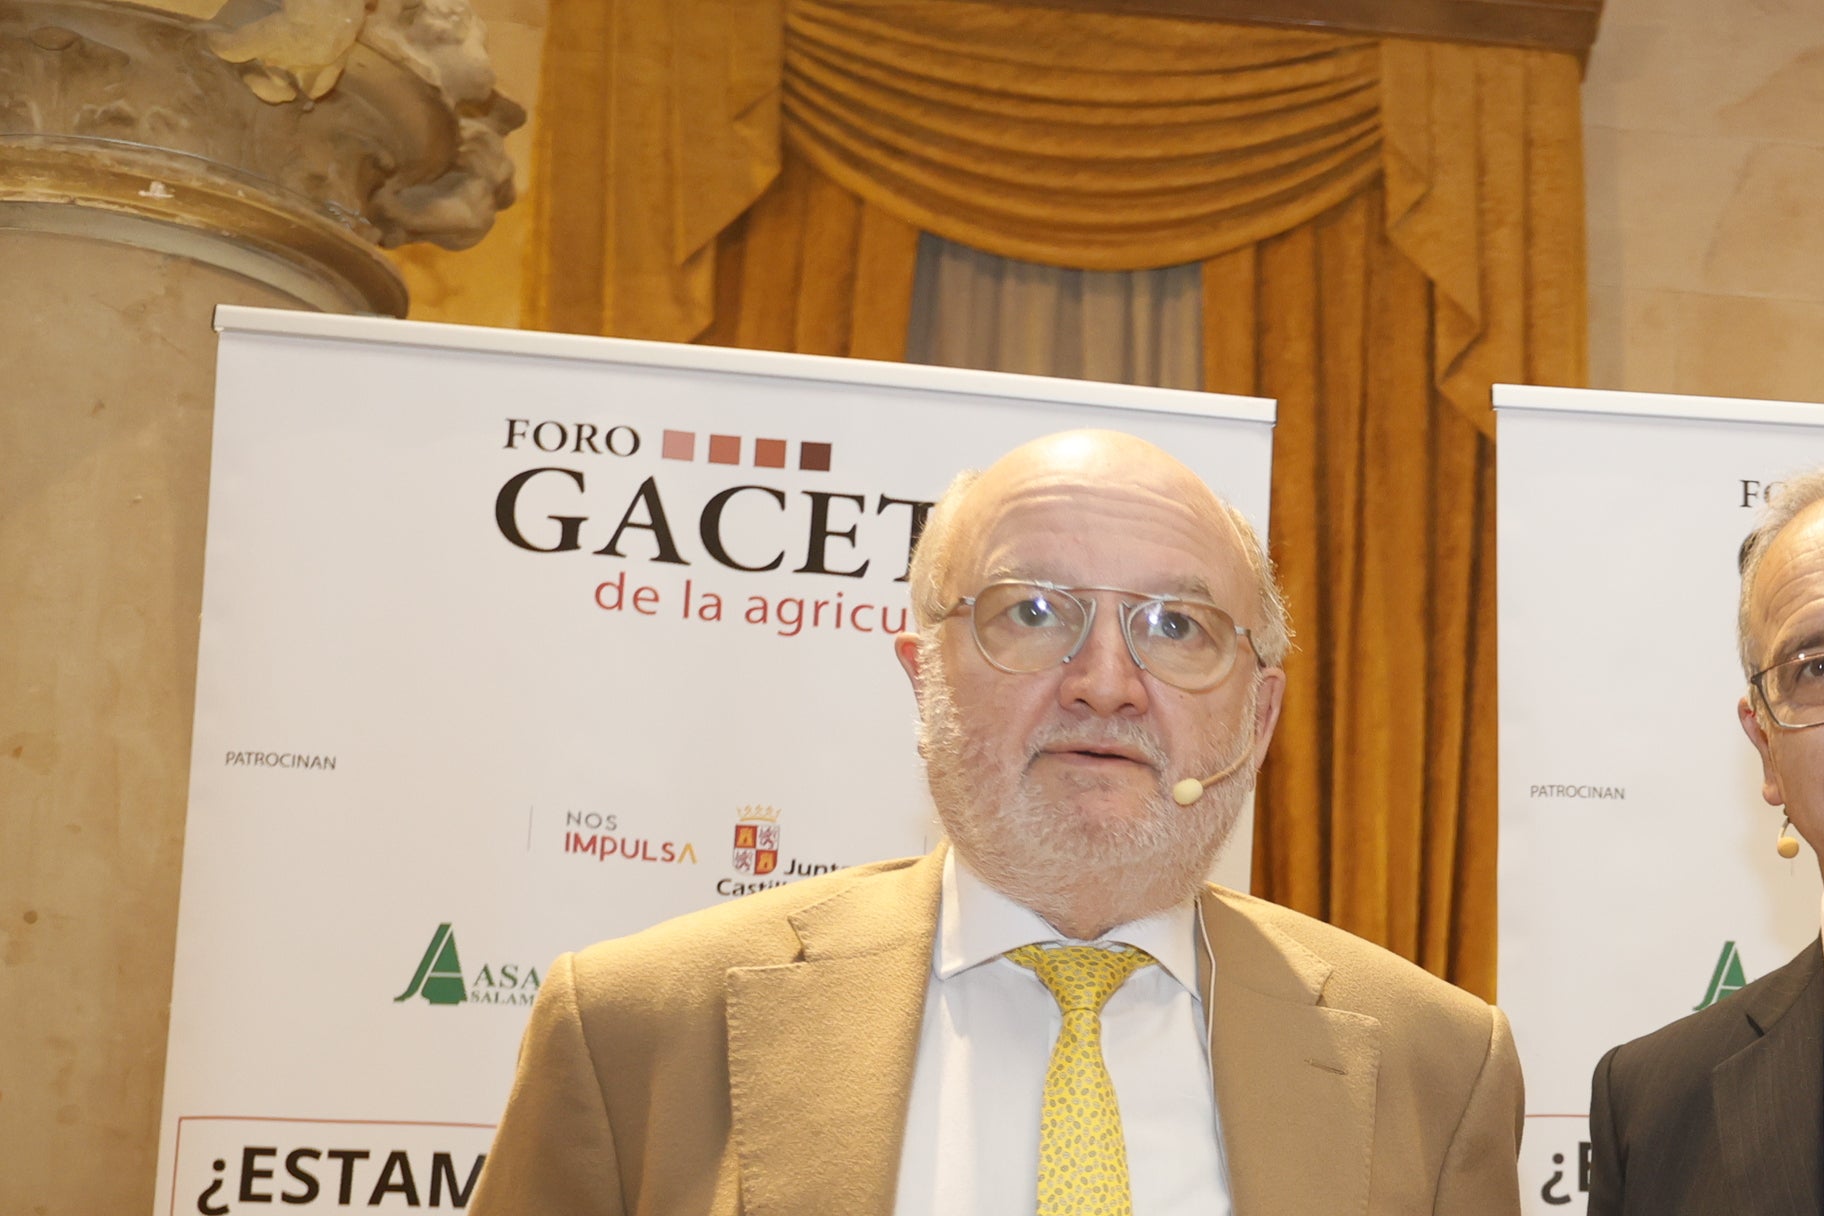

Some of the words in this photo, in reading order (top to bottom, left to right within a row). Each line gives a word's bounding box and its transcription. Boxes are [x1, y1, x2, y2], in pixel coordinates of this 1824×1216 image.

[503, 418, 641, 457] FORO
[494, 466, 938, 582] GACET
[594, 570, 660, 616] de
[682, 578, 723, 622] la
[744, 591, 908, 638] agricu
[224, 750, 337, 771] PATROCINAN
[1529, 784, 1626, 801] PATROCINAN
[565, 810, 618, 831] NOS
[473, 963, 540, 990] ASA
[470, 990, 534, 1006] SALAM
[196, 1146, 488, 1216] ¿ESTAM
